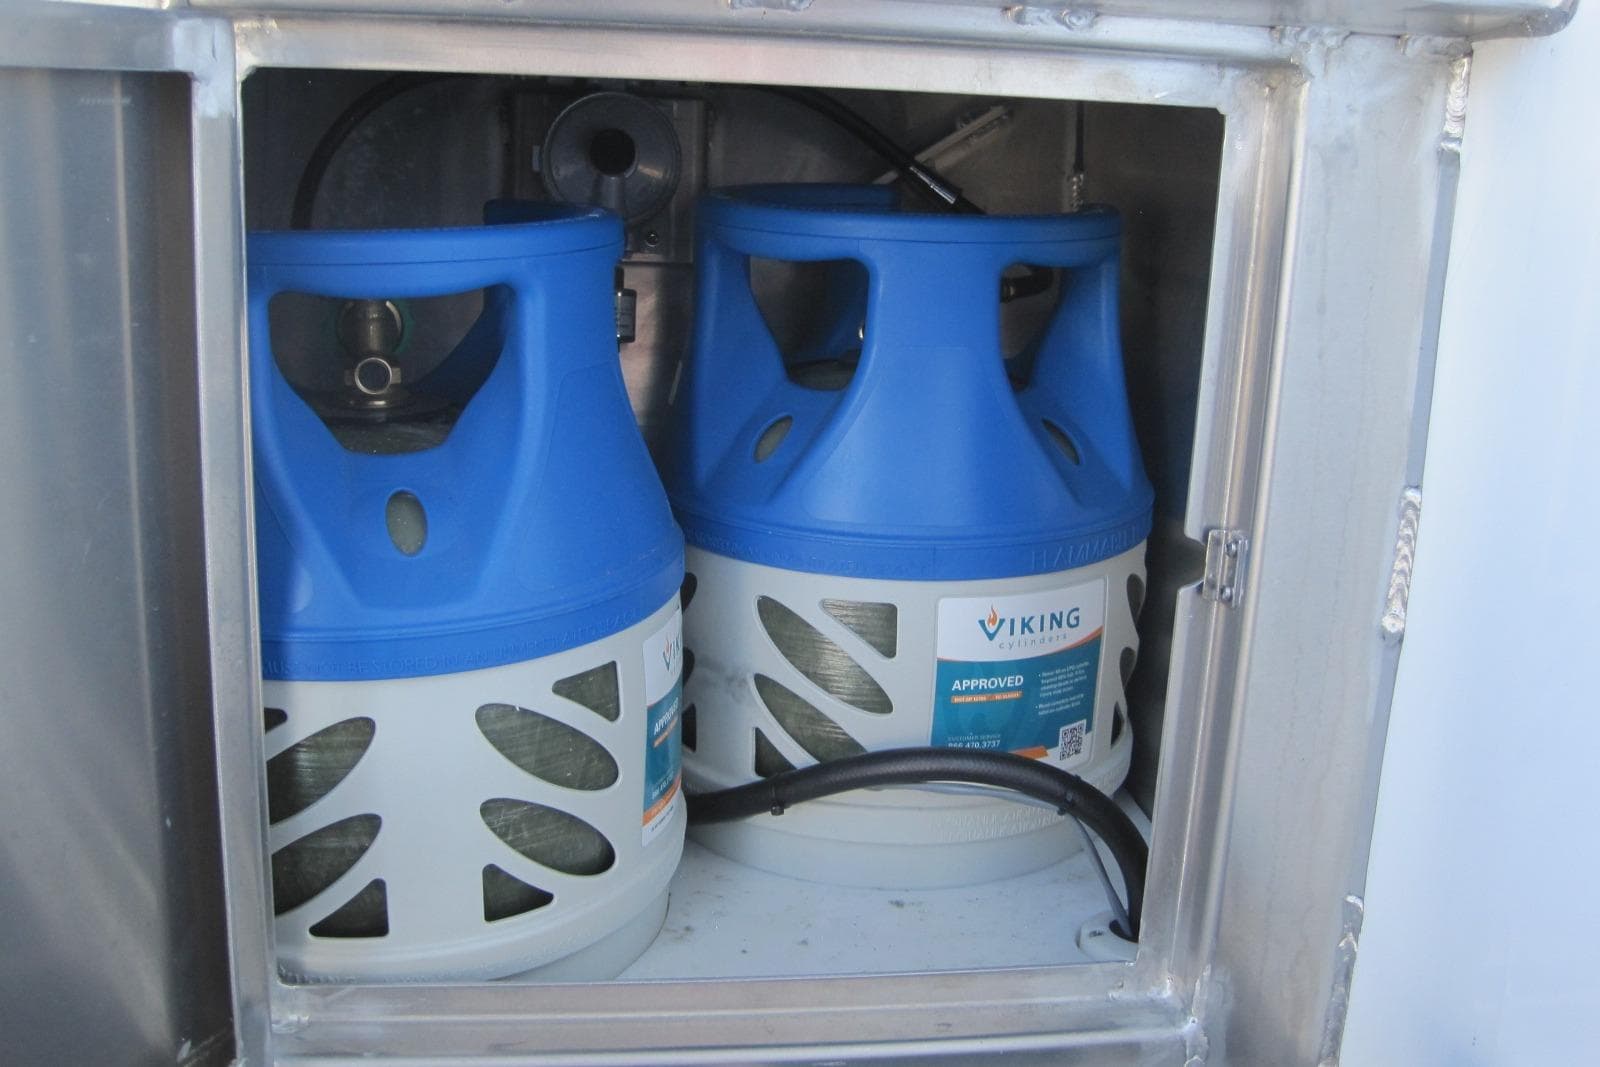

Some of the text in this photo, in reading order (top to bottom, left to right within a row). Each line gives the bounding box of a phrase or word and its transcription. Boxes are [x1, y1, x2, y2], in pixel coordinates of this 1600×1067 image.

[978, 607, 1080, 641] VIKING
[999, 634, 1068, 651] cylinders
[951, 675, 1024, 691] APPROVED
[948, 739, 1001, 749] 866470.3737
